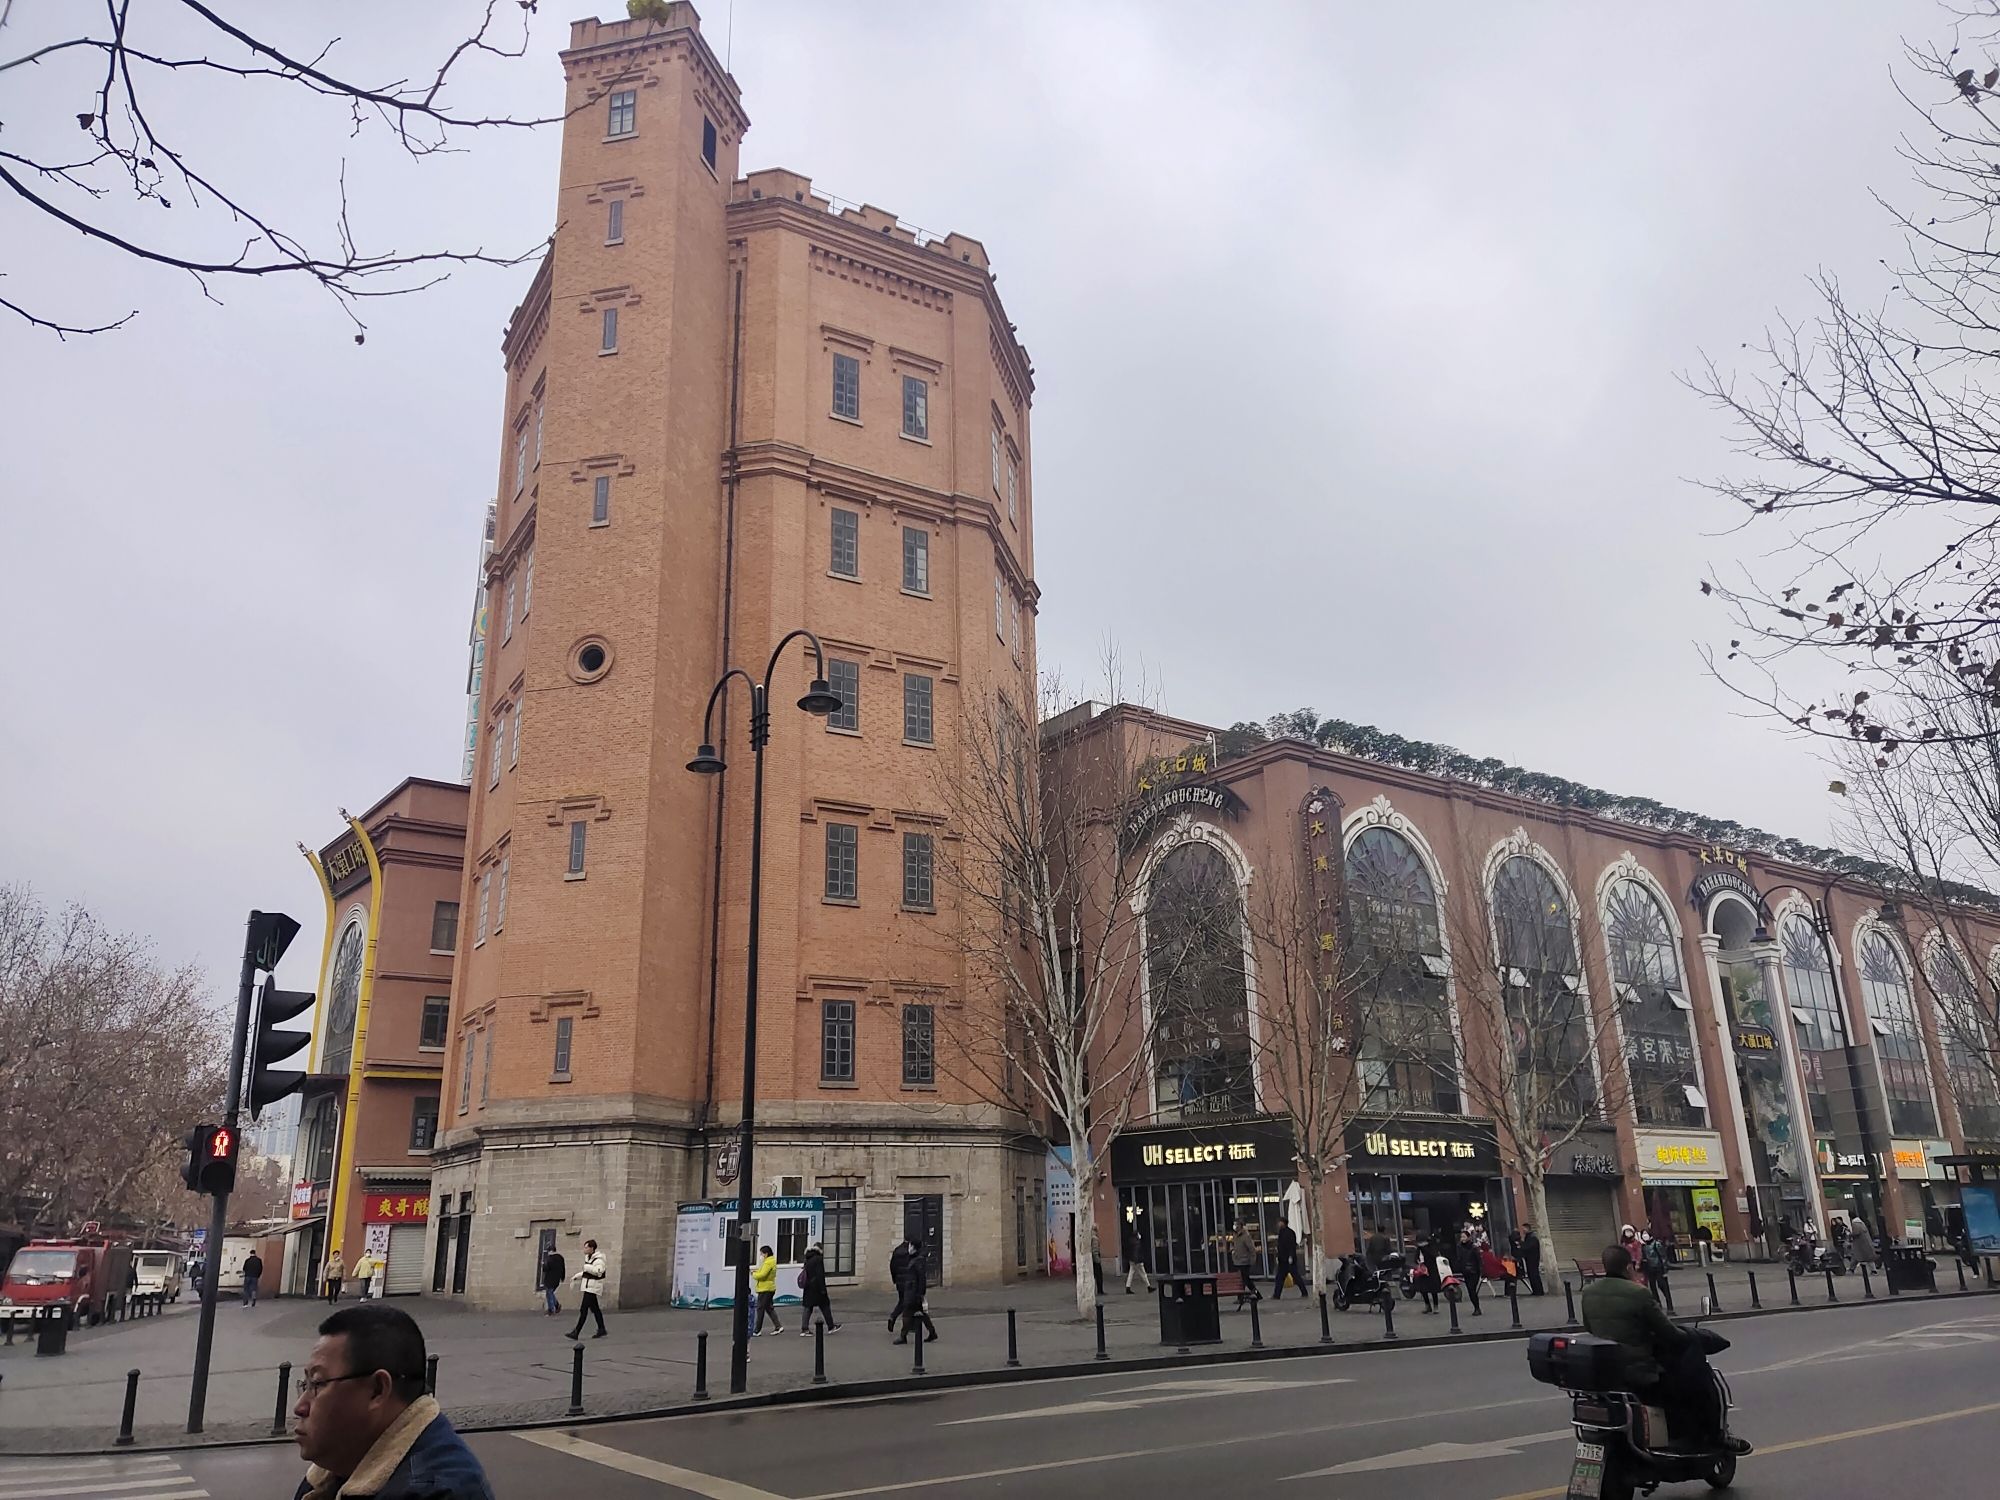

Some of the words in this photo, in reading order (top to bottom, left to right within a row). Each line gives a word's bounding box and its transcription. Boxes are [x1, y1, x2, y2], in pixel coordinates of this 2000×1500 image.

[1143, 1145, 1164, 1166] UH
[1165, 1145, 1224, 1164] SELECT
[1365, 1133, 1388, 1155] UH
[1390, 1139, 1447, 1157] SELECT
[726, 1199, 814, 1210] 江便民发热诊疗站
